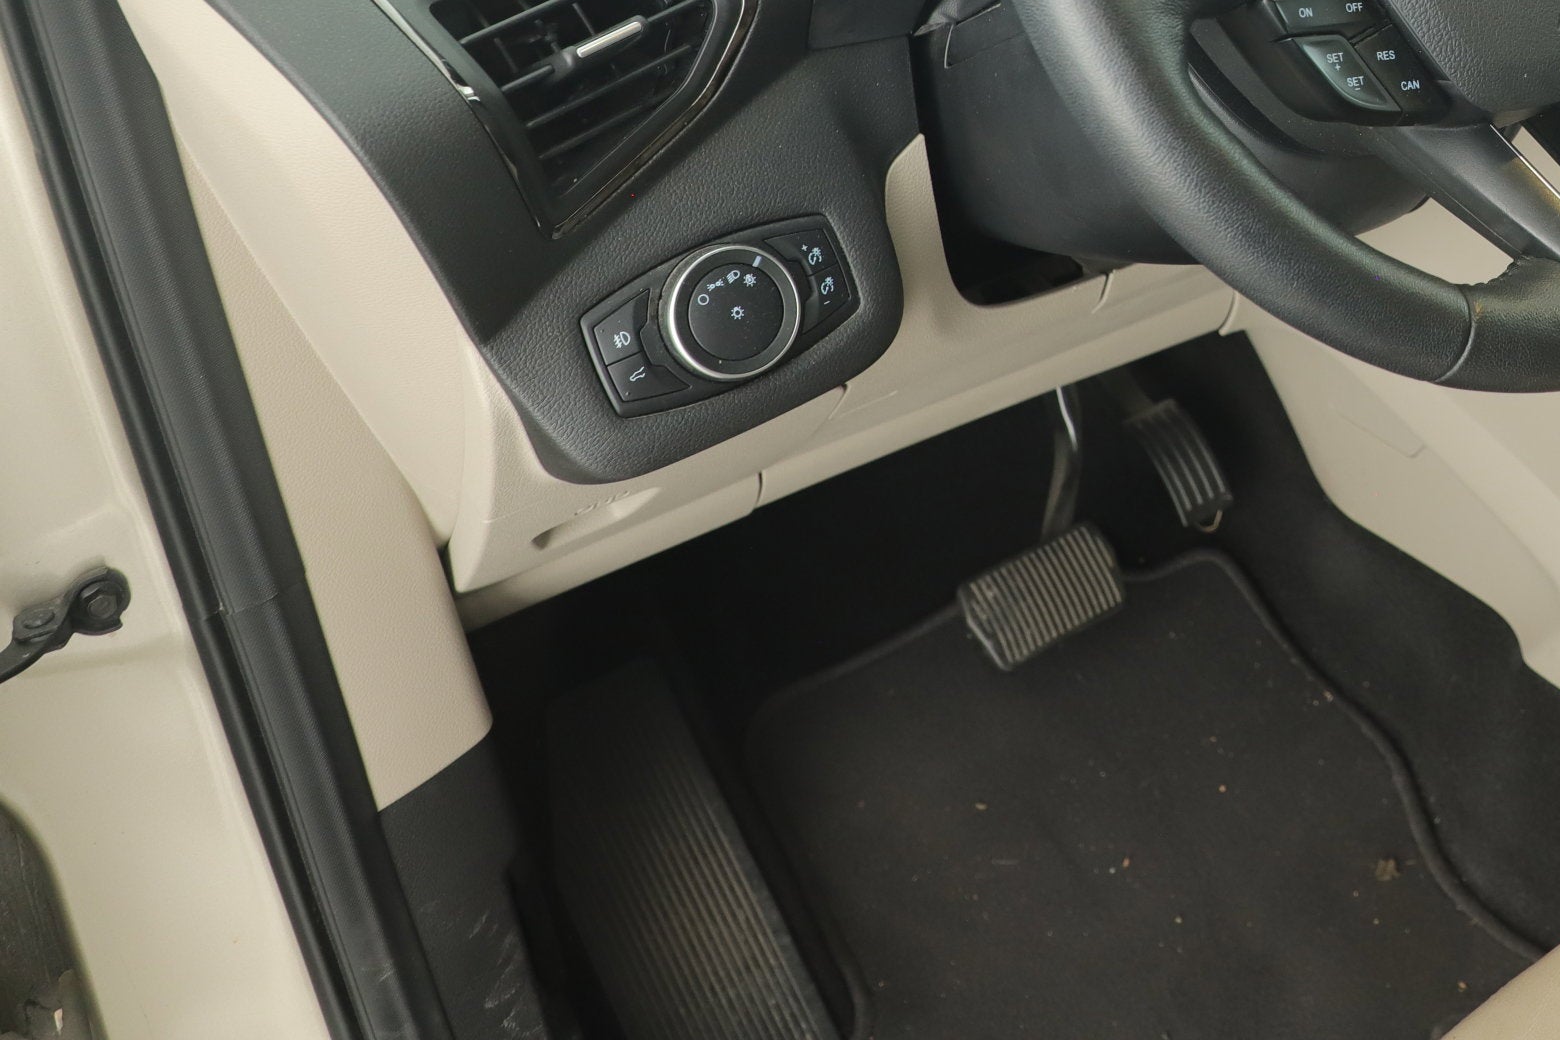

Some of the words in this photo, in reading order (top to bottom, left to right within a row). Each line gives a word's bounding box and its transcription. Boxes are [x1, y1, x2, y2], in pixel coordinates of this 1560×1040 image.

[1298, 7, 1313, 18] ON
[1345, 2, 1363, 13] OFF
[1326, 52, 1344, 63] SET
[1376, 50, 1396, 61] RES
[1346, 75, 1364, 87] SET
[1400, 80, 1420, 91] CAN
